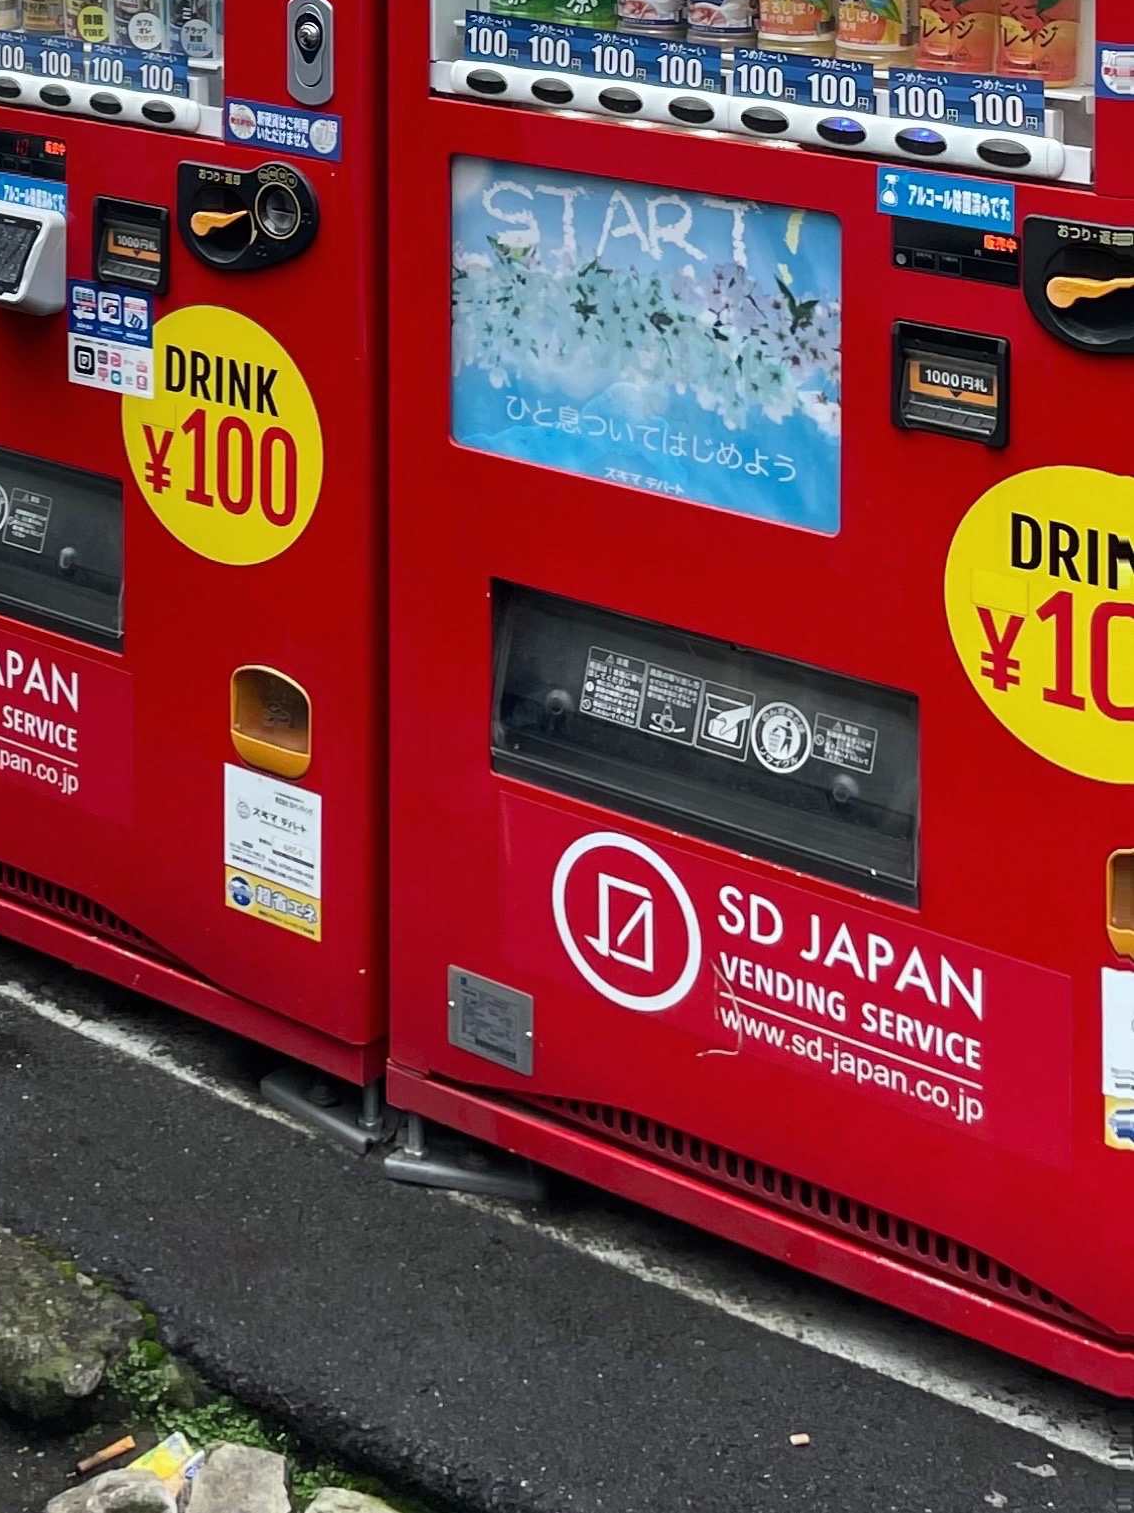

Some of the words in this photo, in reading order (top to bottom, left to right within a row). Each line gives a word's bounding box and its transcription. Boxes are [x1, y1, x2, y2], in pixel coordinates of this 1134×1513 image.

[166, 344, 279, 418] DRINK
[925, 368, 988, 393] 1000円札
[142, 408, 298, 527] ¥100
[506, 394, 797, 484] ひと息ついてはじめよう
[2, 705, 78, 752] SERVICE
[255, 884, 318, 924] 超省エネ
[717, 884, 784, 947] SD
[800, 913, 984, 1021] JAPAN
[719, 952, 847, 1022] VENDING
[861, 1002, 982, 1072] SERVICE
[718, 1004, 984, 1123] www.sd-japan.co.jp
